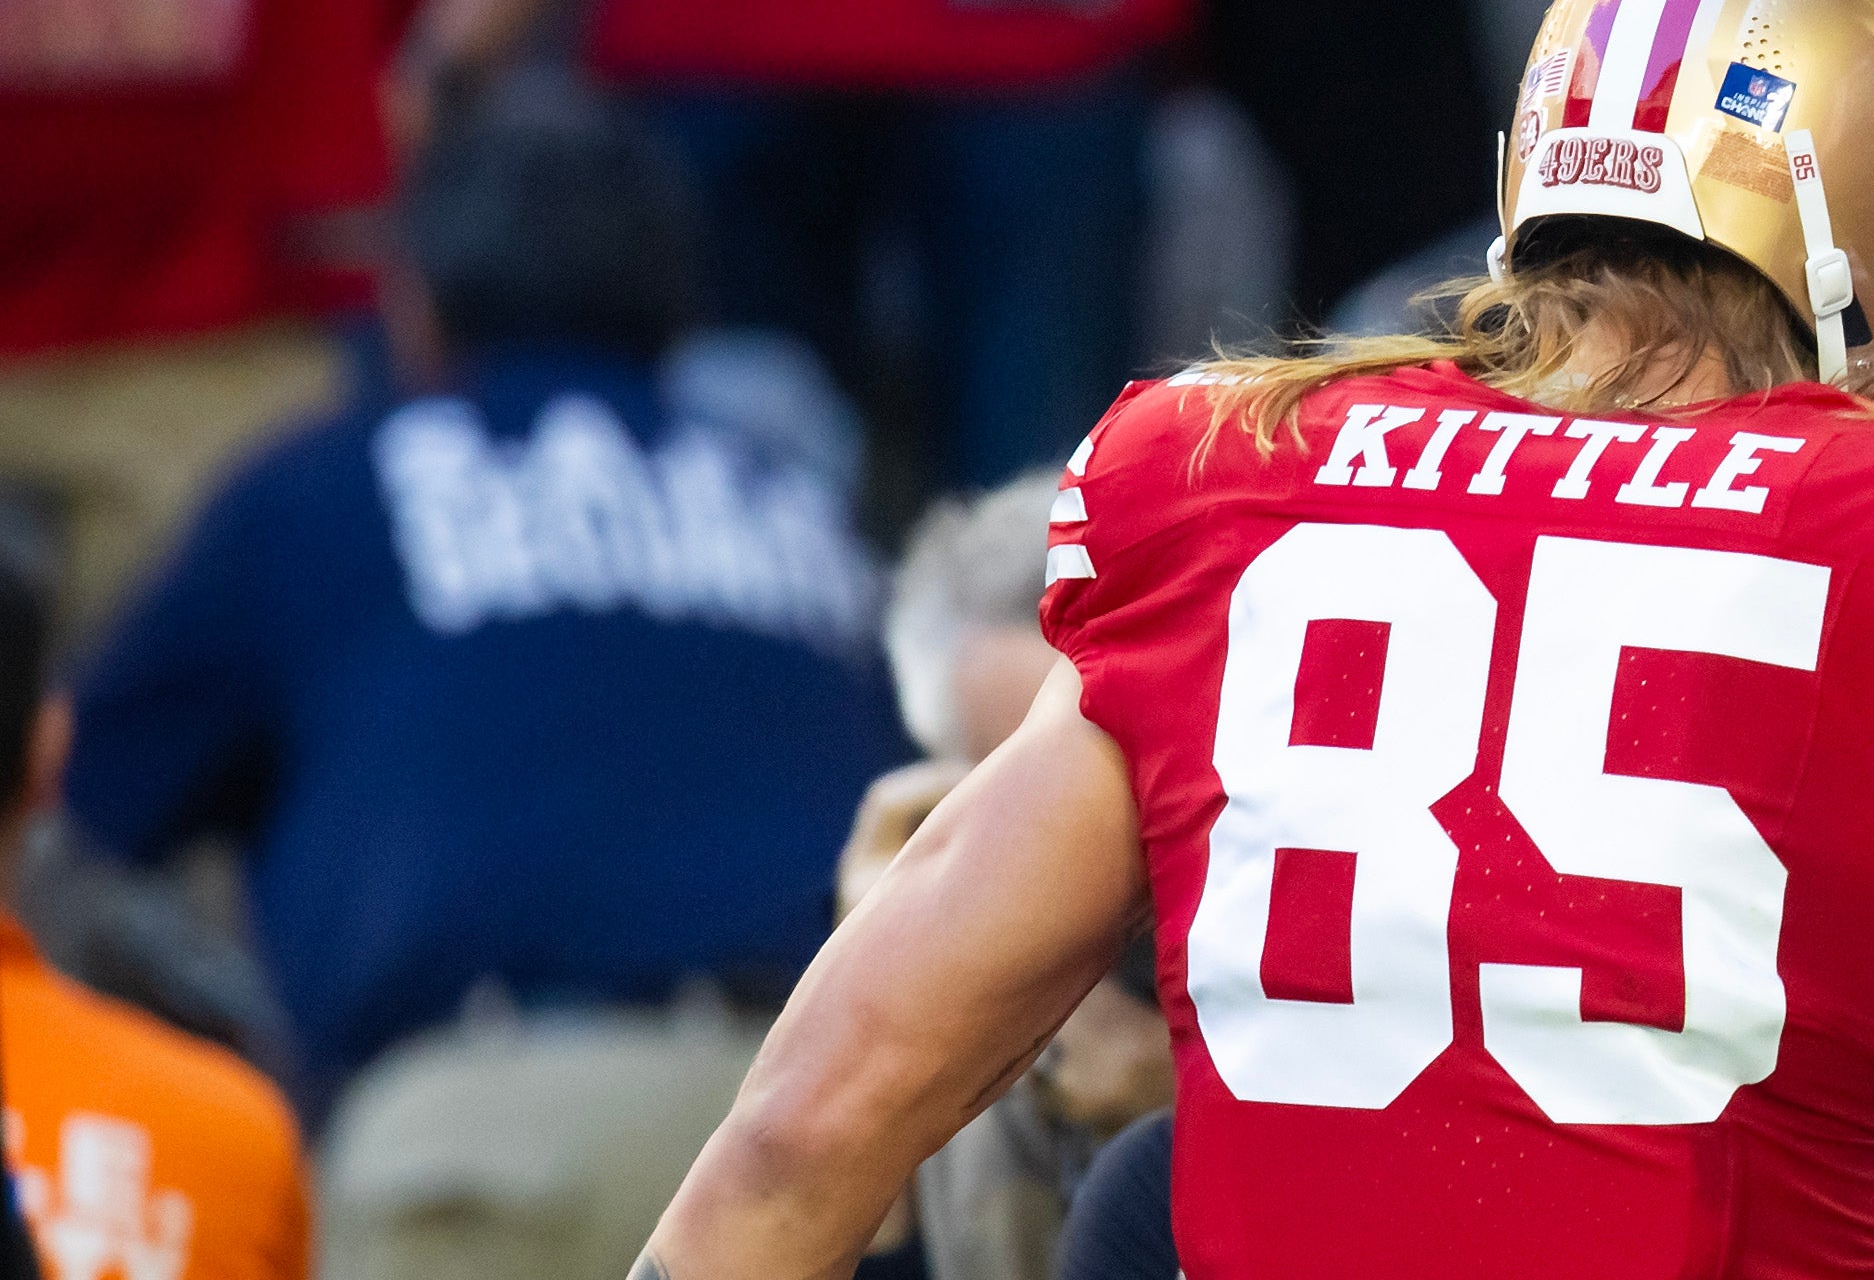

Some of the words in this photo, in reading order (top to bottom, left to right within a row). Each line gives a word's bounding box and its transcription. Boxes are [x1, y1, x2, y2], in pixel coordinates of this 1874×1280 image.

[1538, 137, 1664, 194] 49ERS
[1793, 154, 1816, 180] 85
[1312, 403, 1806, 515] KITTLE
[1187, 522, 1832, 1124] 85
